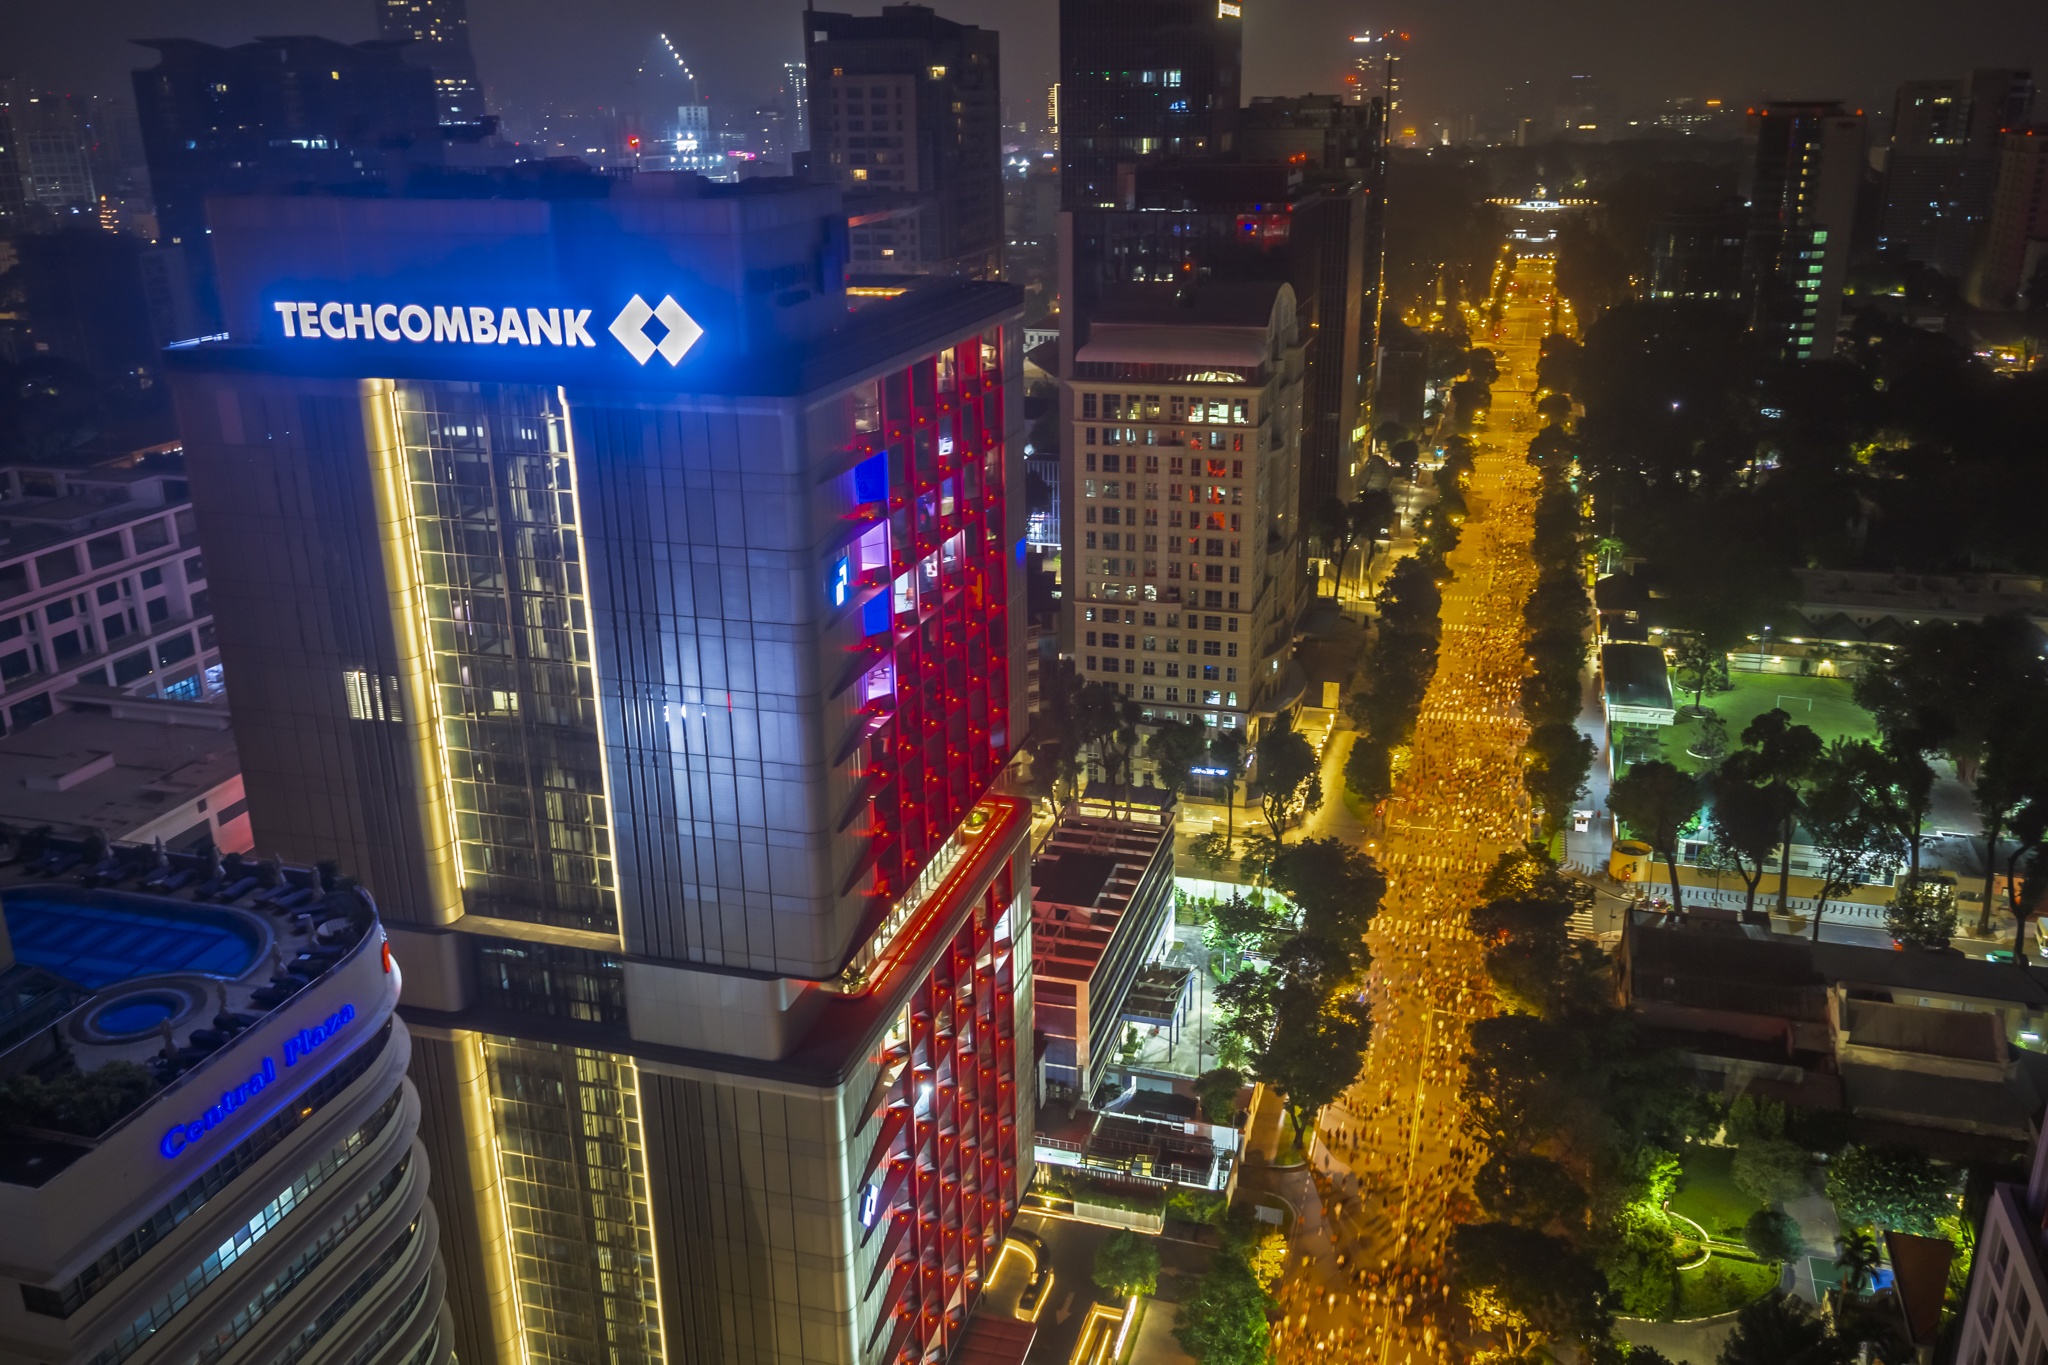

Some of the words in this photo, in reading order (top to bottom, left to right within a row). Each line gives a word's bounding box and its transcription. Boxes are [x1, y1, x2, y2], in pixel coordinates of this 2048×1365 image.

[274, 302, 596, 347] TECHCOMBANK
[161, 1057, 276, 1159] Central
[284, 1005, 355, 1067] Plaza
